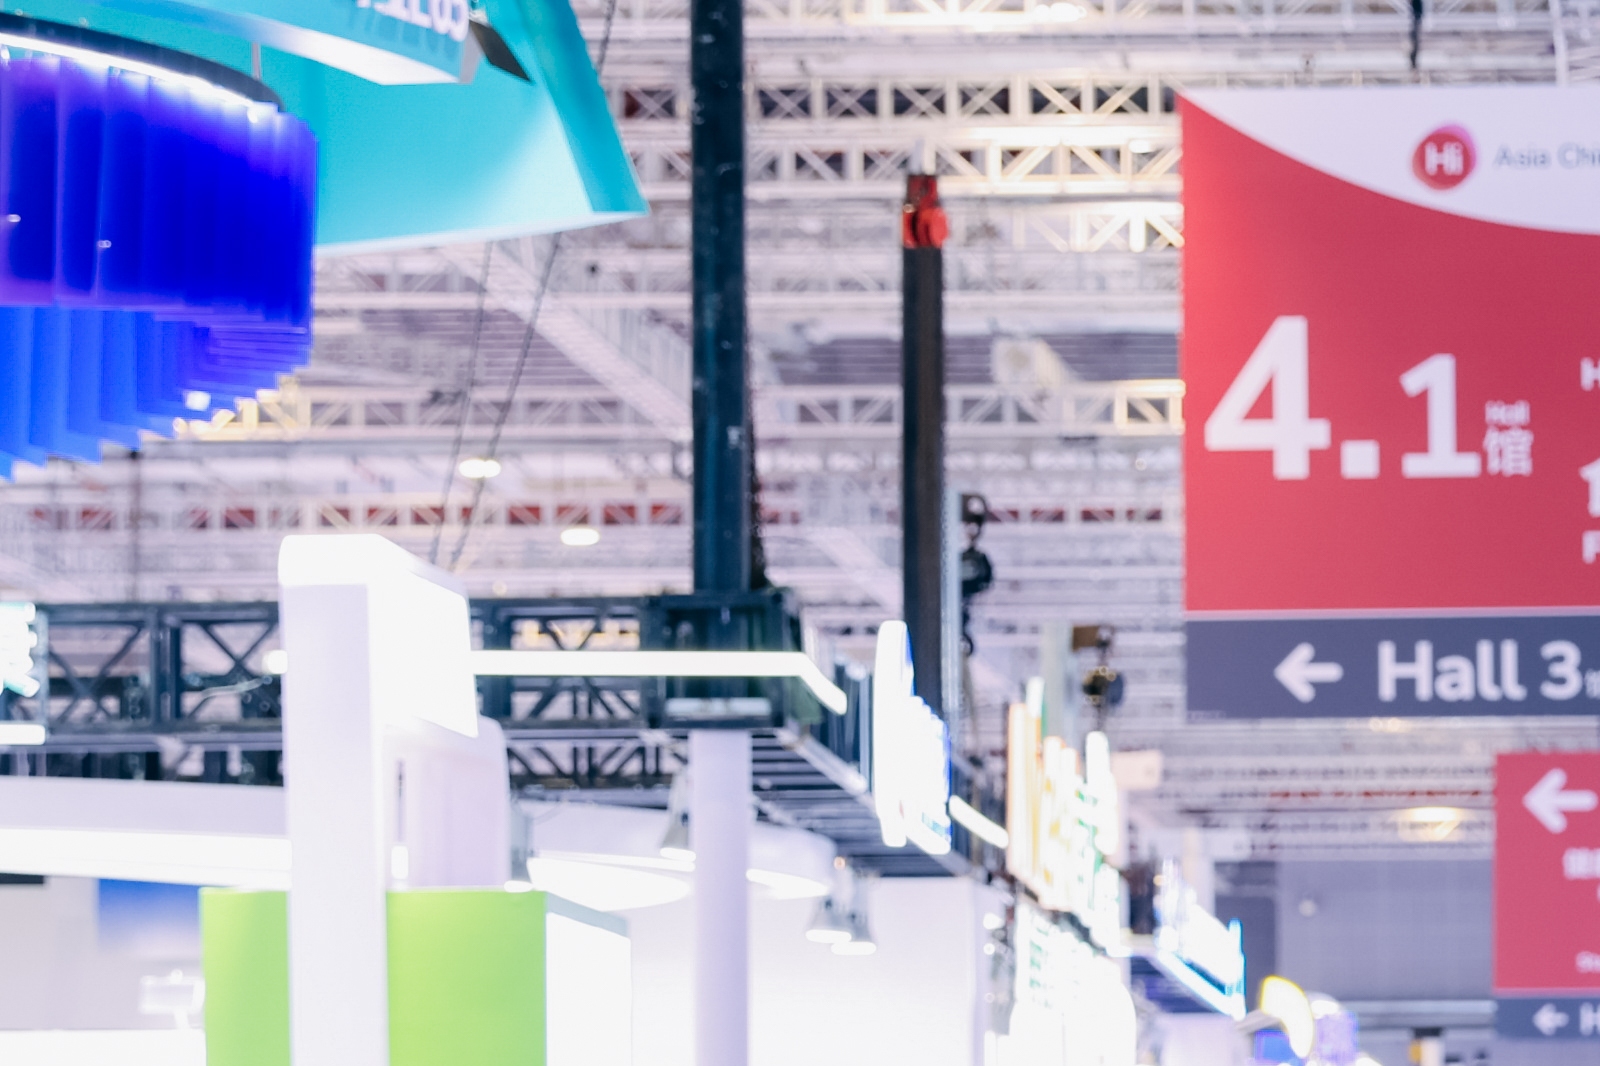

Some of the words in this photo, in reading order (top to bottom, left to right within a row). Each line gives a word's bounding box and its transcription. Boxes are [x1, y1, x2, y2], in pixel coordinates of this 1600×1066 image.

[1424, 140, 1464, 177] Hi
[1493, 144, 1551, 169] Asia
[1204, 315, 1482, 480] 4.1
[1377, 639, 1527, 702] Hall
